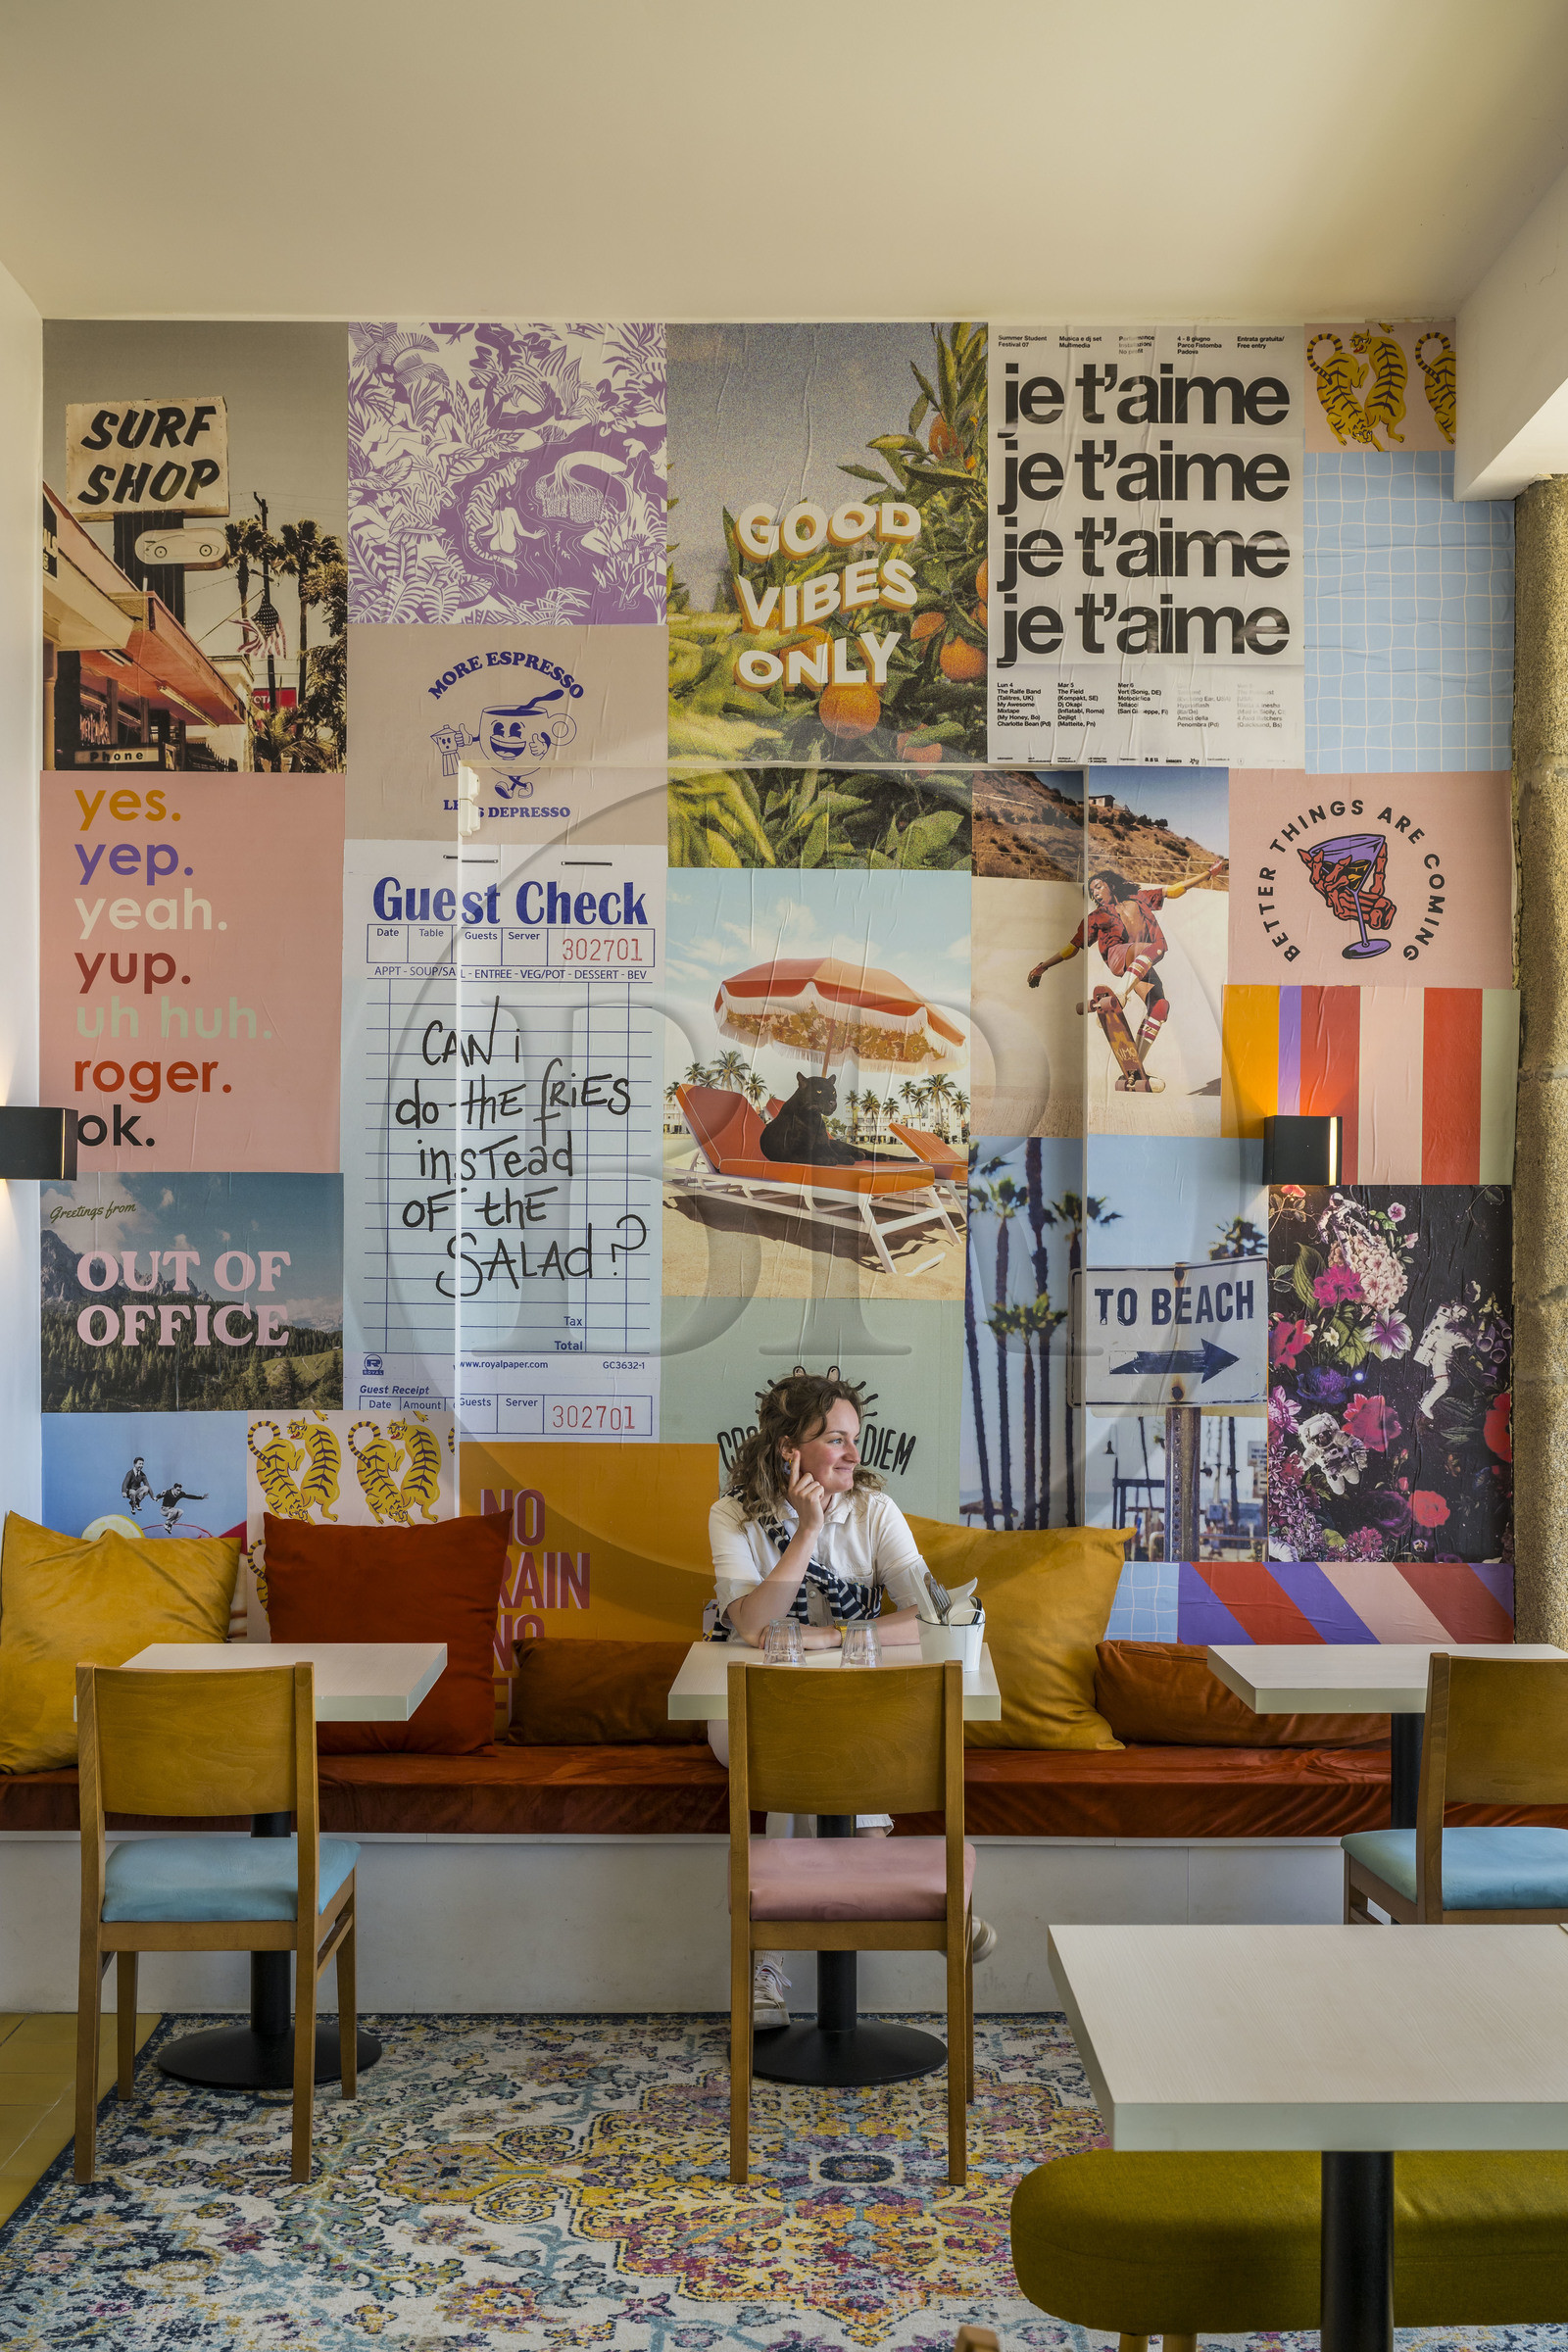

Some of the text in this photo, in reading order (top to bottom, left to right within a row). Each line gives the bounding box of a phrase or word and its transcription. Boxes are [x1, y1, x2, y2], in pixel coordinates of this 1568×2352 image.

[997, 363, 1290, 438] je t'aime
[81, 406, 217, 451] SURF
[77, 458, 220, 507] SHOP
[997, 439, 1290, 515] je t'aime
[735, 501, 922, 561] GOOD
[997, 516, 1290, 592] je t'aime
[735, 558, 918, 638] VIBES
[997, 593, 1290, 668] je t'aime
[428, 651, 584, 700] MORE ESPRESSO
[734, 631, 903, 689] ONLY
[90, 751, 144, 762] Phone
[74, 789, 181, 831] yes.
[443, 800, 571, 818] LES DEPRESSO
[74, 844, 193, 886] yep.
[1258, 800, 1446, 962] BETTER THINGS ARE COMING
[74, 888, 227, 940] yeah.
[373, 877, 648, 925] Guest Check
[376, 927, 643, 962] Date Table Guests Server 302701
[74, 953, 191, 994] yup.
[374, 965, 401, 977] APPT
[474, 968, 513, 979] ENTREE
[520, 969, 565, 980] VEG/POT
[574, 969, 618, 980] DESSERT
[627, 970, 647, 980] BEV
[76, 996, 273, 1039] uh huh.
[422, 995, 501, 1067] CAN
[74, 1060, 232, 1103] roger.
[395, 1078, 439, 1129] do
[77, 1104, 156, 1147] ok.
[49, 1200, 136, 1224] Greetings from
[76, 1250, 292, 1292] OUT OF
[76, 1301, 290, 1348] OFFICE
[564, 1316, 583, 1327] Tax
[1094, 1279, 1254, 1327] TO BEACH
[460, 1359, 549, 1372] www.royalpaper.com
[554, 1339, 583, 1351] Total
[602, 1360, 645, 1370] GC3632-1
[360, 1385, 430, 1396] Guest Receipt
[368, 1396, 636, 1431] Date Amount Guests Server 302701
[859, 1423, 916, 1476] DIEM
[480, 1489, 545, 1546] NO
